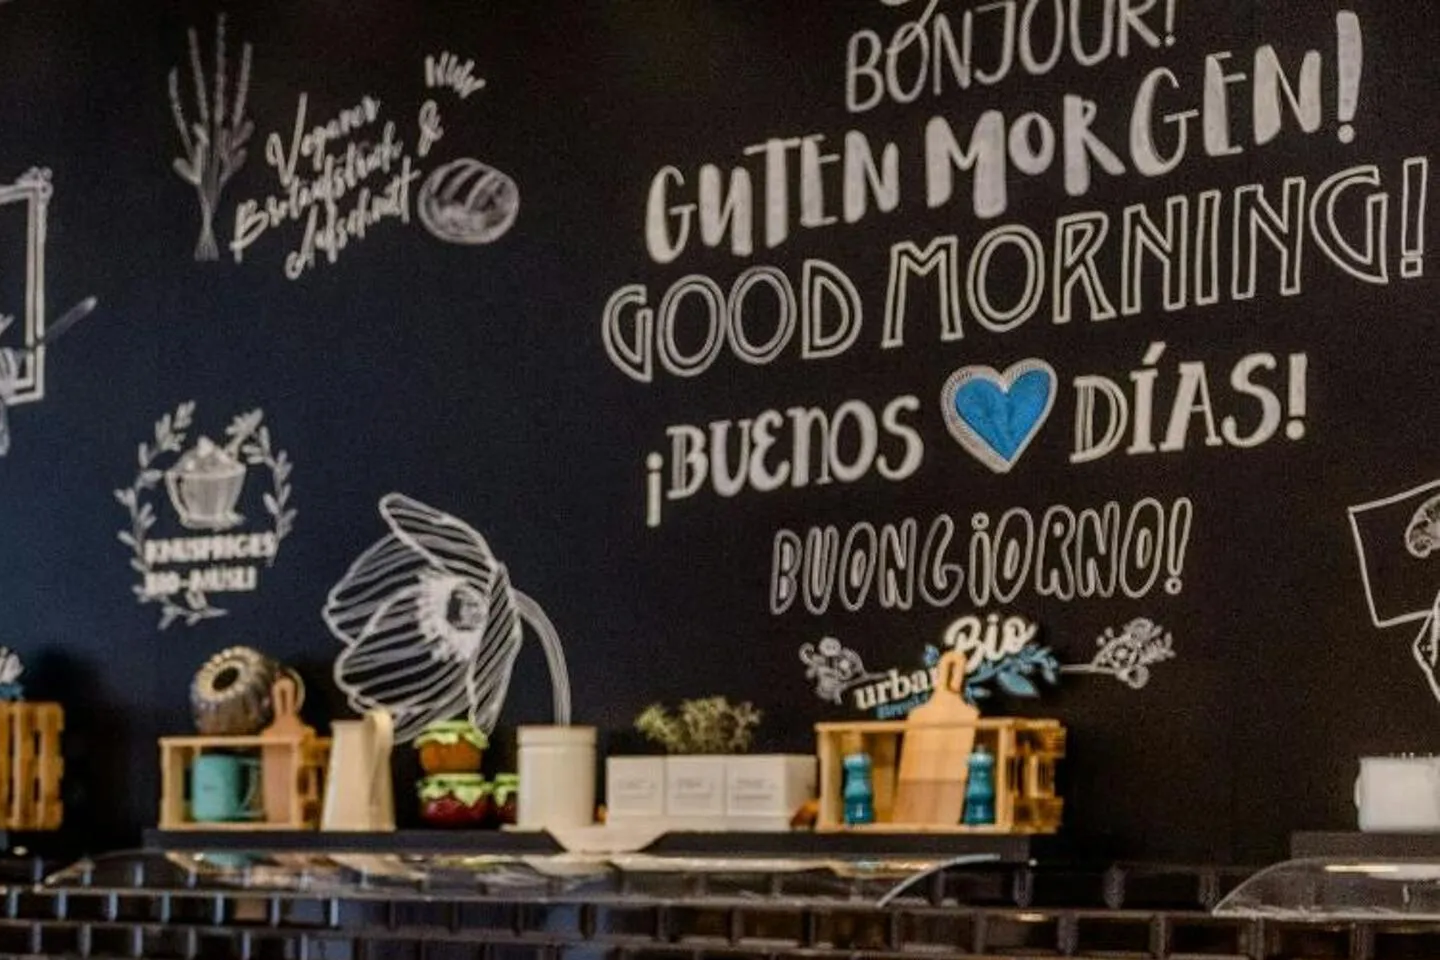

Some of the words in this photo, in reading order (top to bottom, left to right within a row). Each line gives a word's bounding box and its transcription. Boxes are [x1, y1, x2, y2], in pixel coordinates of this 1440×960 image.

[846, 0, 1176, 112] BONJOUR!
[645, 130, 900, 264] GUTEN
[925, 10, 1362, 218] MORGEN!
[602, 259, 863, 383] GOOD
[882, 158, 1428, 348] MORNING!
[1069, 341, 1308, 464] DÍAS!
[944, 613, 1039, 674] Bio
